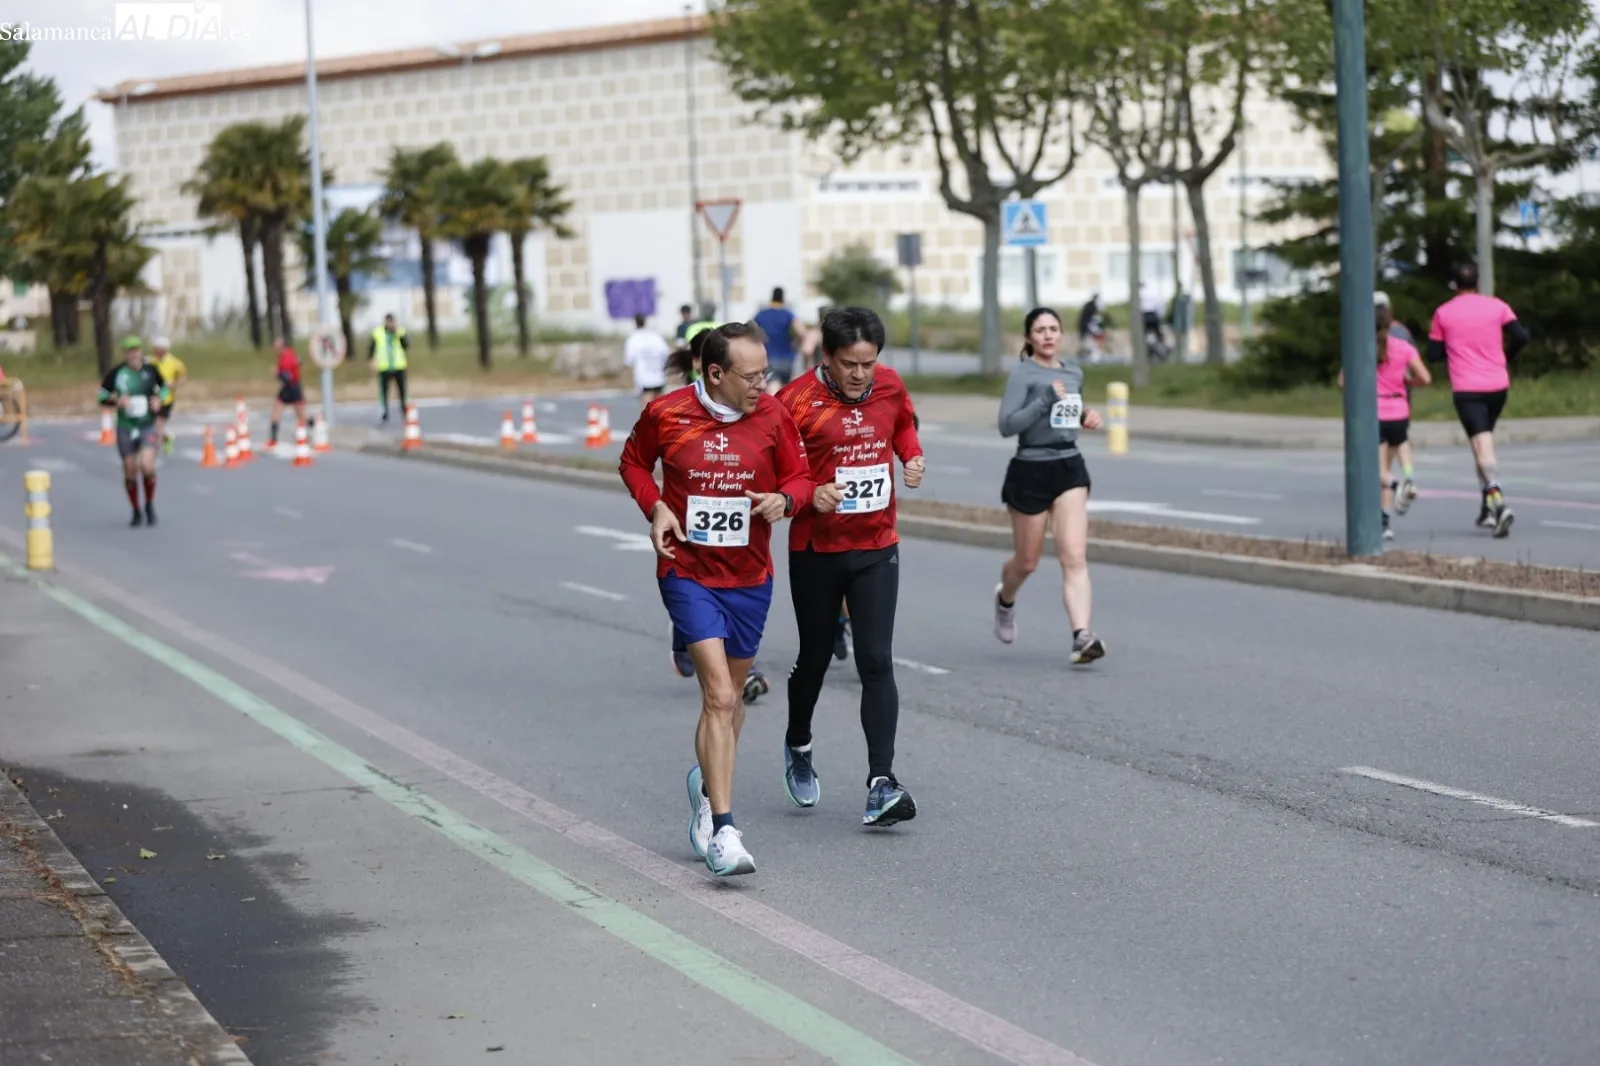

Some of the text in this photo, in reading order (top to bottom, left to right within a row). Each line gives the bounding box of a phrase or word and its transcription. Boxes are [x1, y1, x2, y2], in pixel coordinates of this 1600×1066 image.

[713, 472, 725, 481] por
[727, 470, 734, 480] la
[736, 470, 755, 480] salud
[717, 480, 742, 492] deporte
[844, 478, 885, 499] 327
[695, 511, 743, 531] 326
